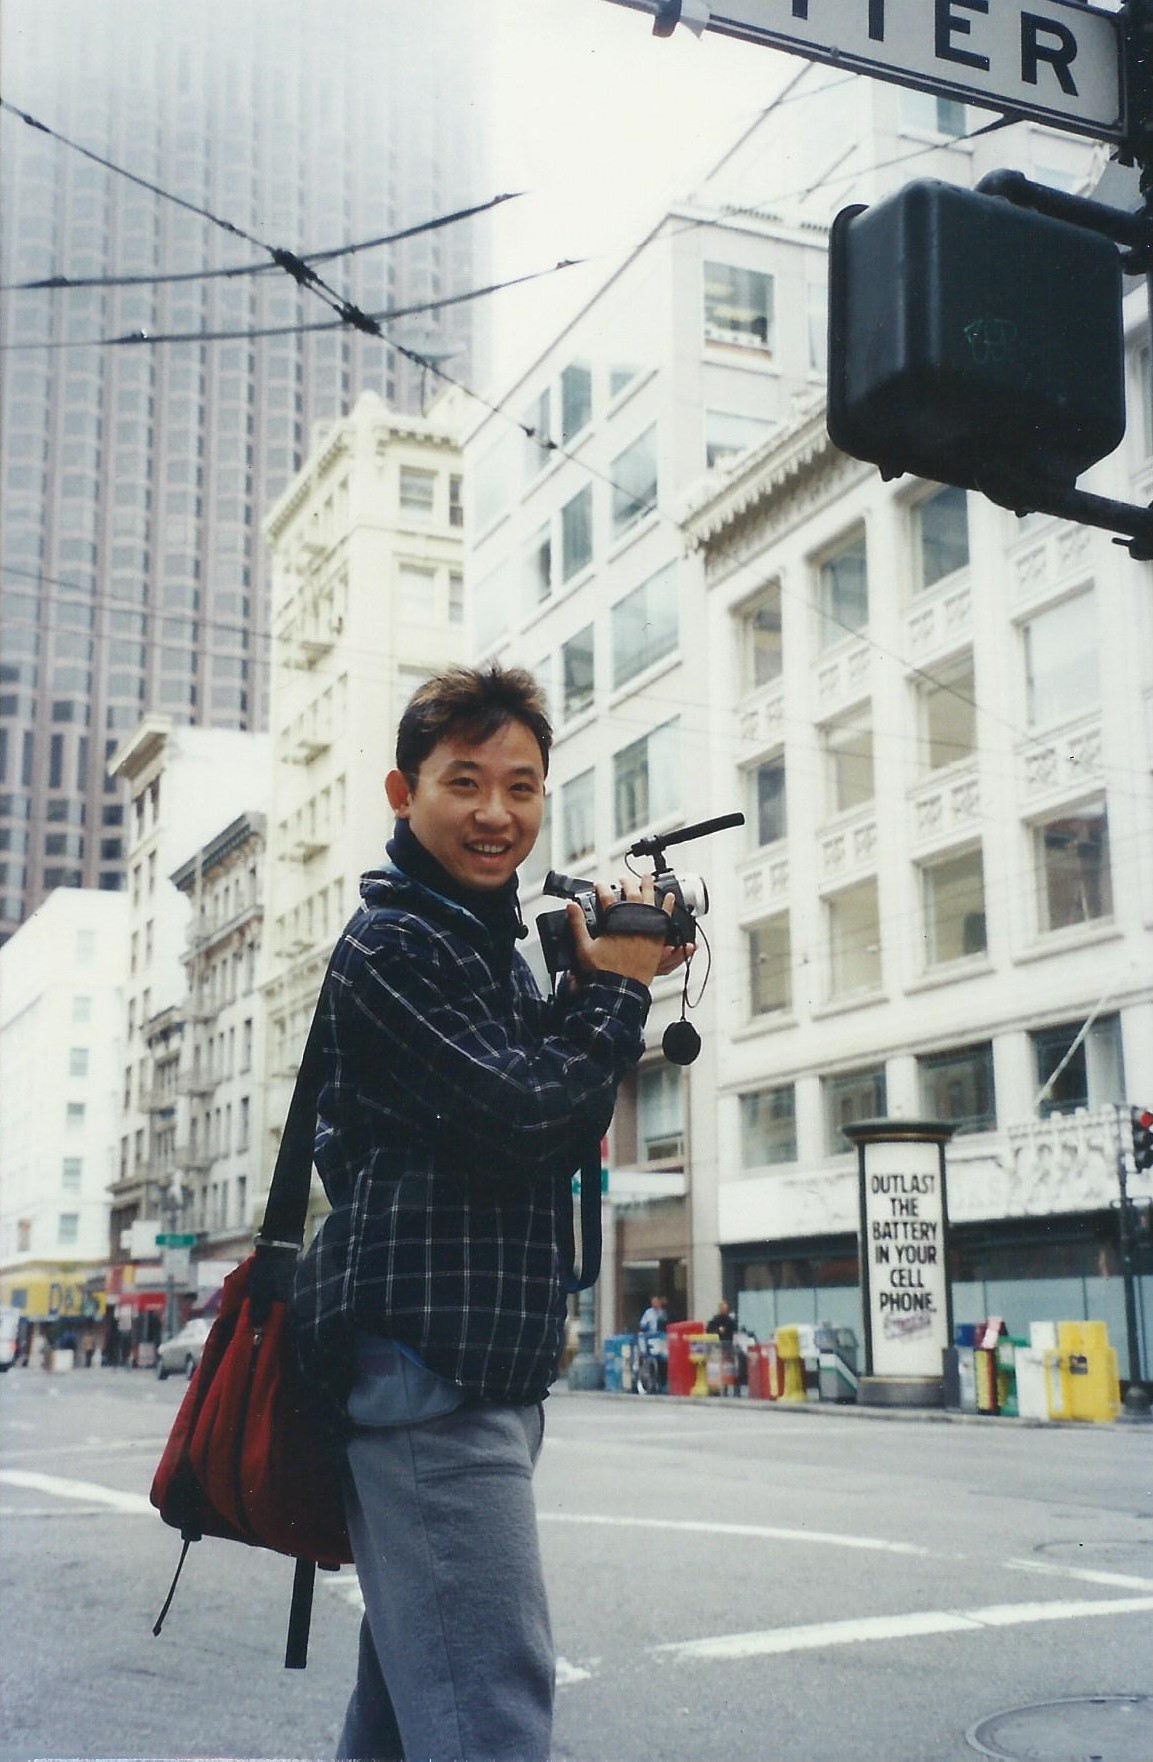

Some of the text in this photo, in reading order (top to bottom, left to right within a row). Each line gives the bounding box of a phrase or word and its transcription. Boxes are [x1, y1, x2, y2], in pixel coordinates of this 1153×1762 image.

[872, 1175, 935, 1194] OUTLAST
[890, 1198, 919, 1217] THE
[872, 1222, 937, 1241] BATTERY
[875, 1246, 937, 1264] IN YOUR
[890, 1269, 924, 1288] CELL
[880, 1292, 937, 1312] PHONE.
